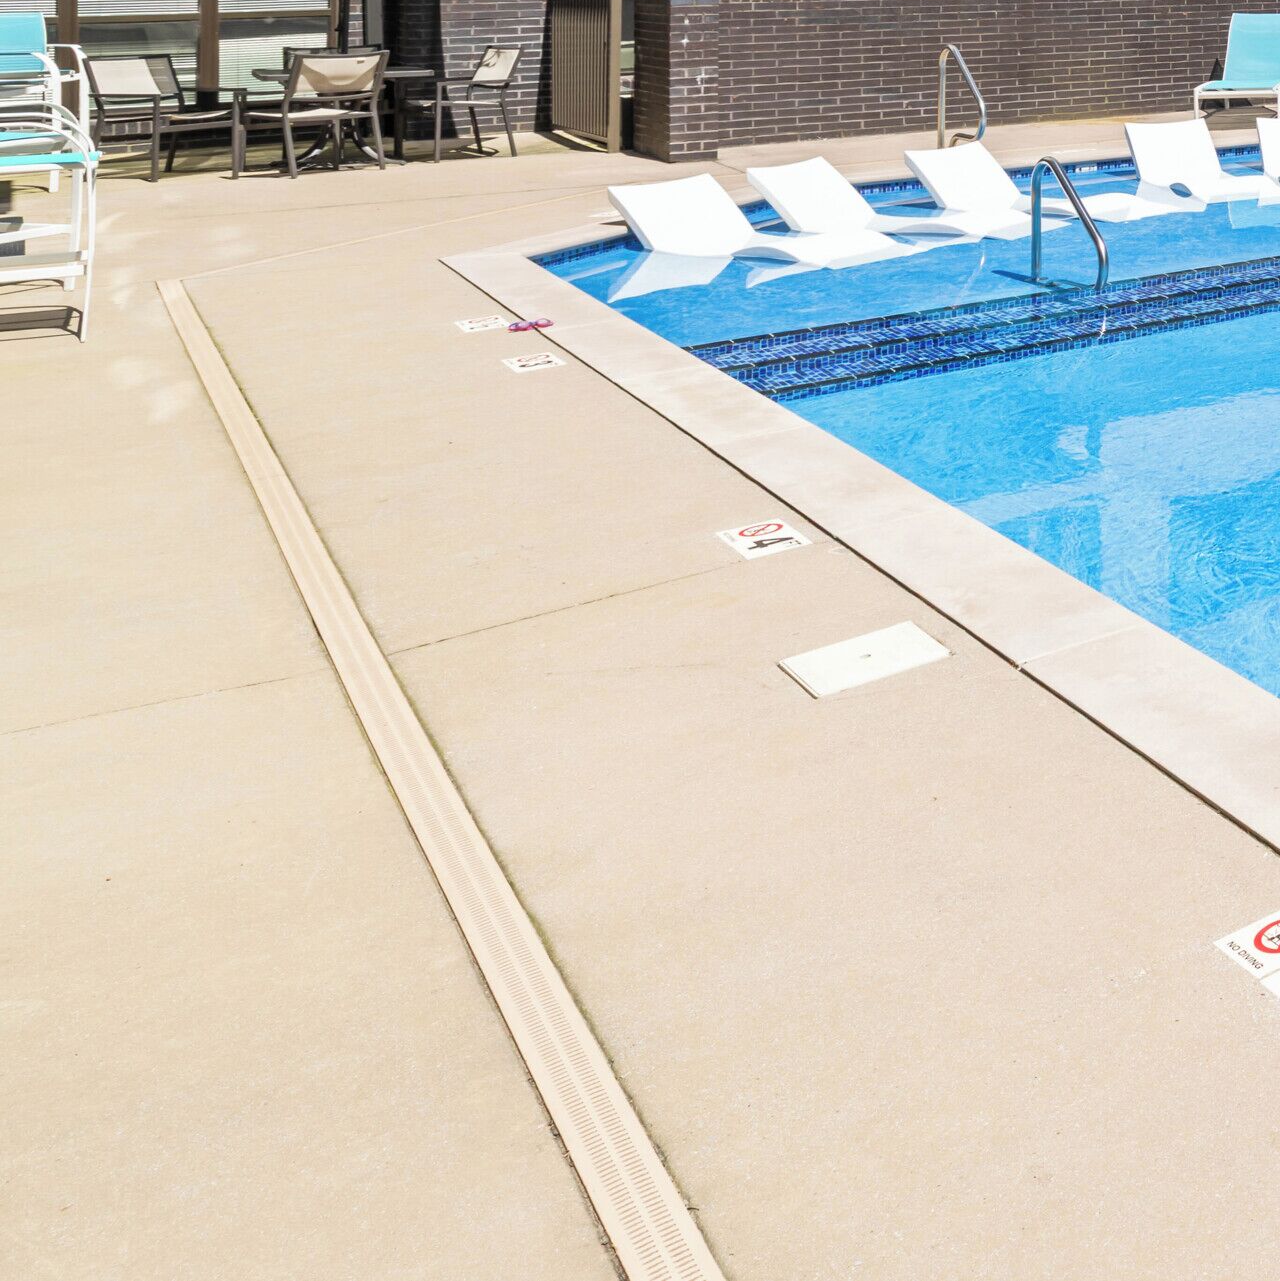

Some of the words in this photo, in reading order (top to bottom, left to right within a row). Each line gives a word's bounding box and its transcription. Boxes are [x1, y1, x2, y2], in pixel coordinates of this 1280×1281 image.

[747, 536, 794, 550] 4
[1226, 940, 1240, 952] NO
[1237, 948, 1264, 970] DIVING
